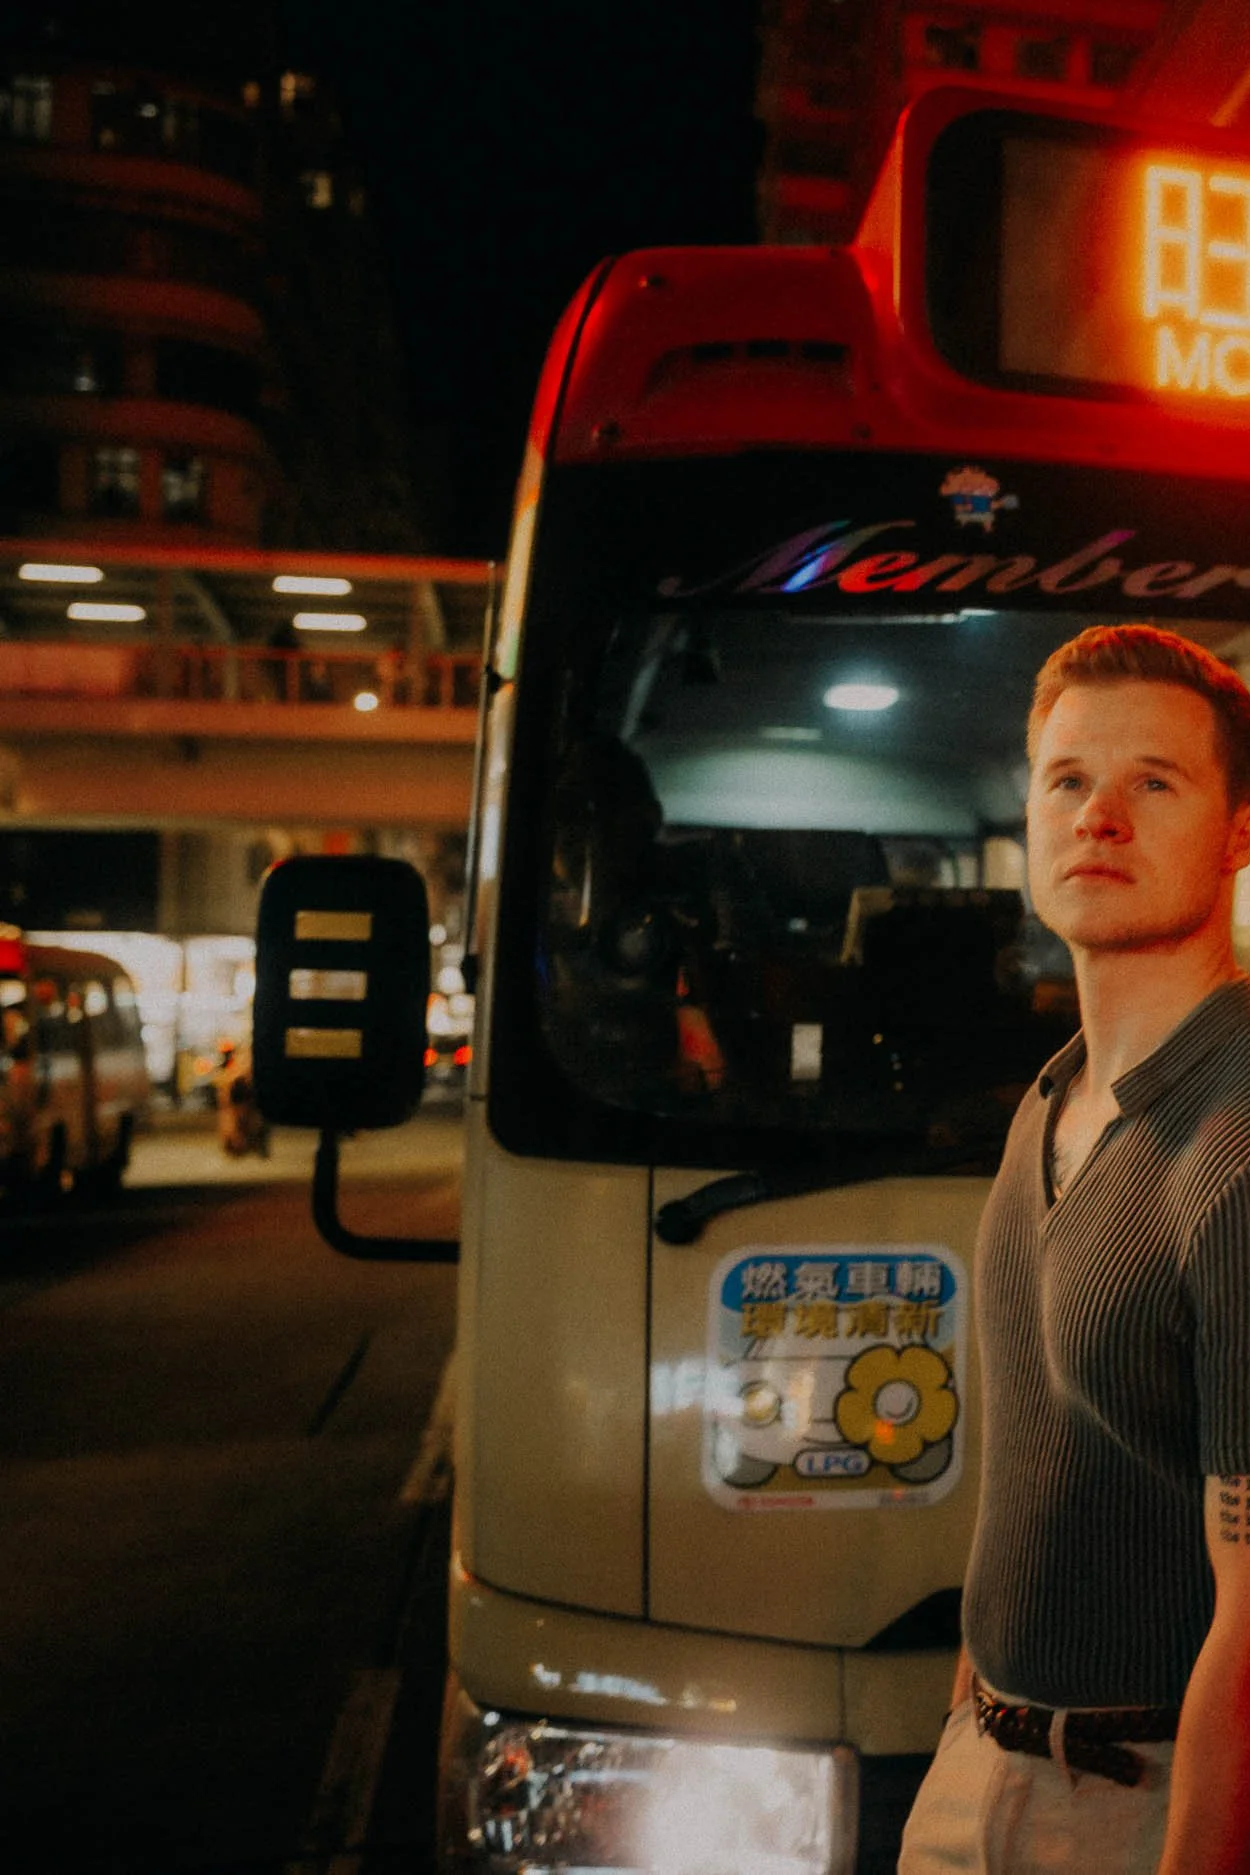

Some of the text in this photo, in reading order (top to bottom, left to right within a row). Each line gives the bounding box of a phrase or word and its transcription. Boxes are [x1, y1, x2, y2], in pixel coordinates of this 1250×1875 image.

[741, 1261, 943, 1300] 燃氣車輛
[806, 1454, 863, 1473] LPG
